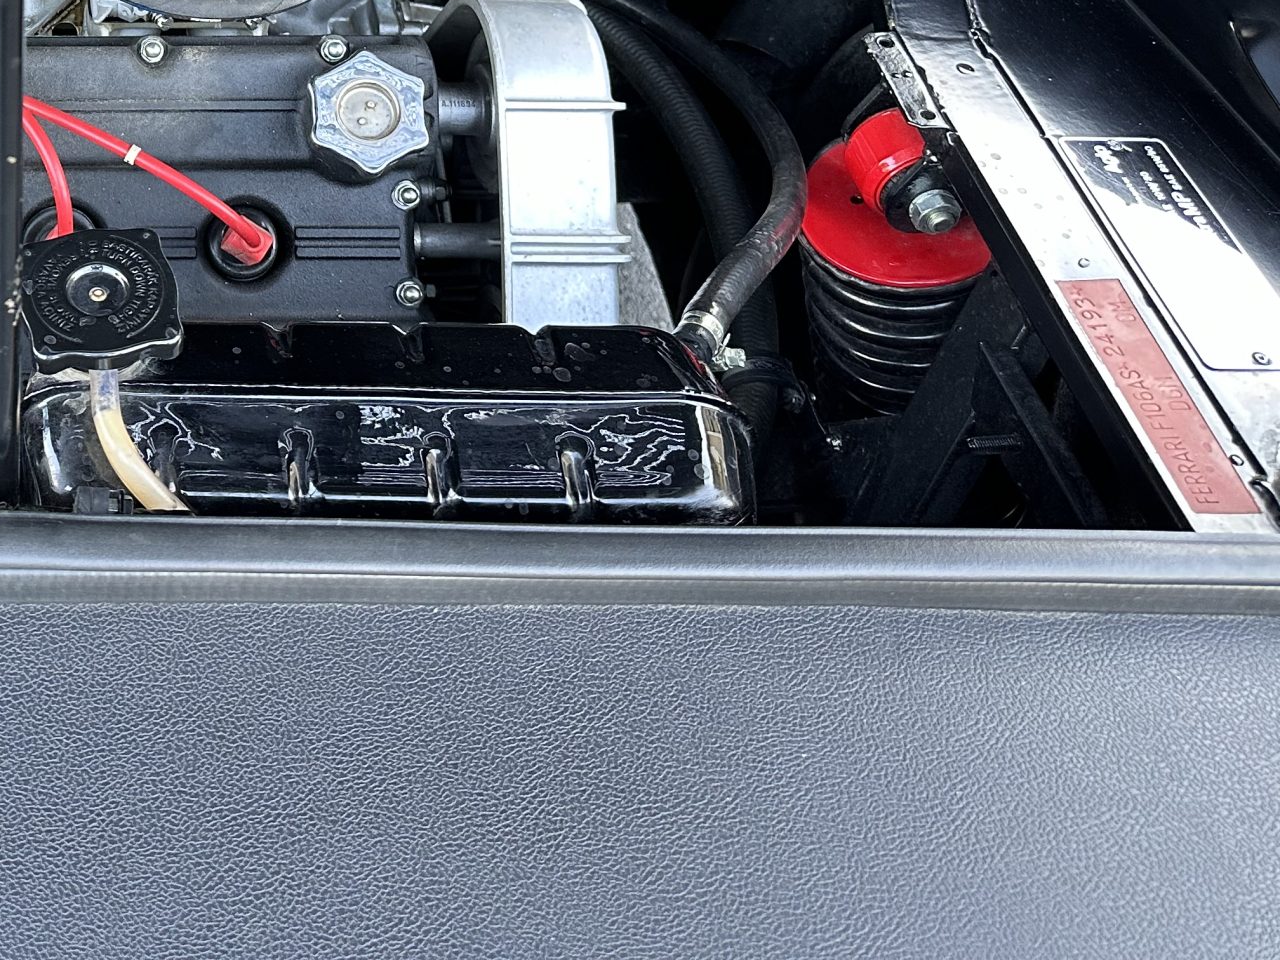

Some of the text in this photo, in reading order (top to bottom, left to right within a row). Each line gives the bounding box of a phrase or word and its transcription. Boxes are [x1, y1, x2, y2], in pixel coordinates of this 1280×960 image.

[128, 266, 146, 297] DOWN
[1071, 297, 1220, 504] FERRARI F106AS 24193
